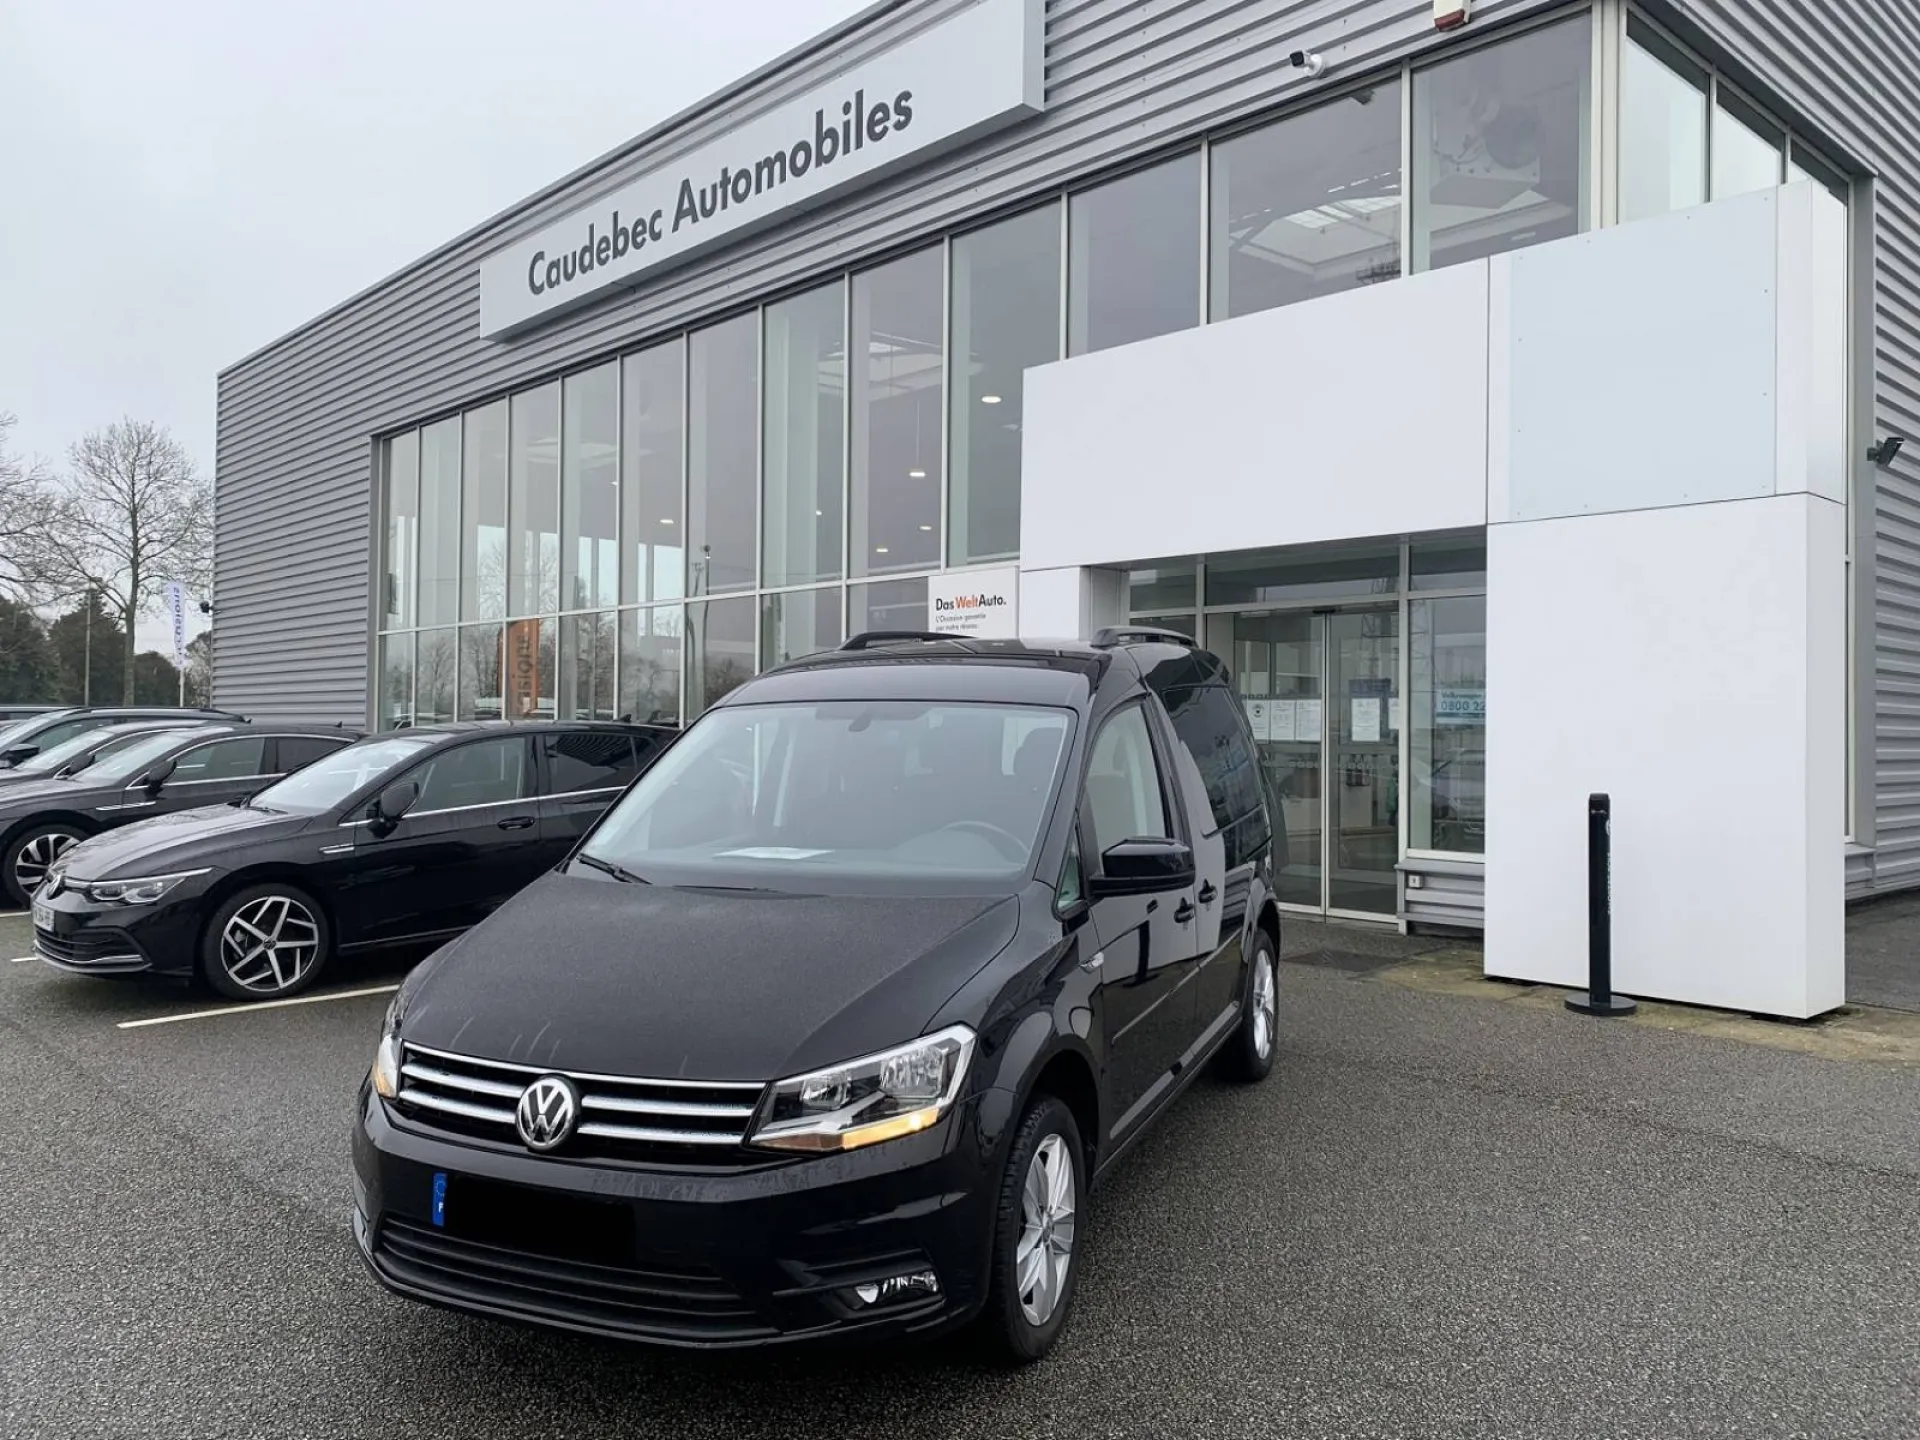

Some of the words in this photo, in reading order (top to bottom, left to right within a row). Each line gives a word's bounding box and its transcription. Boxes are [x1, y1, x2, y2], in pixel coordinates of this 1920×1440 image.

[528, 210, 662, 296] Caudebec
[671, 88, 913, 233] Automobiles
[935, 598, 954, 611] Das
